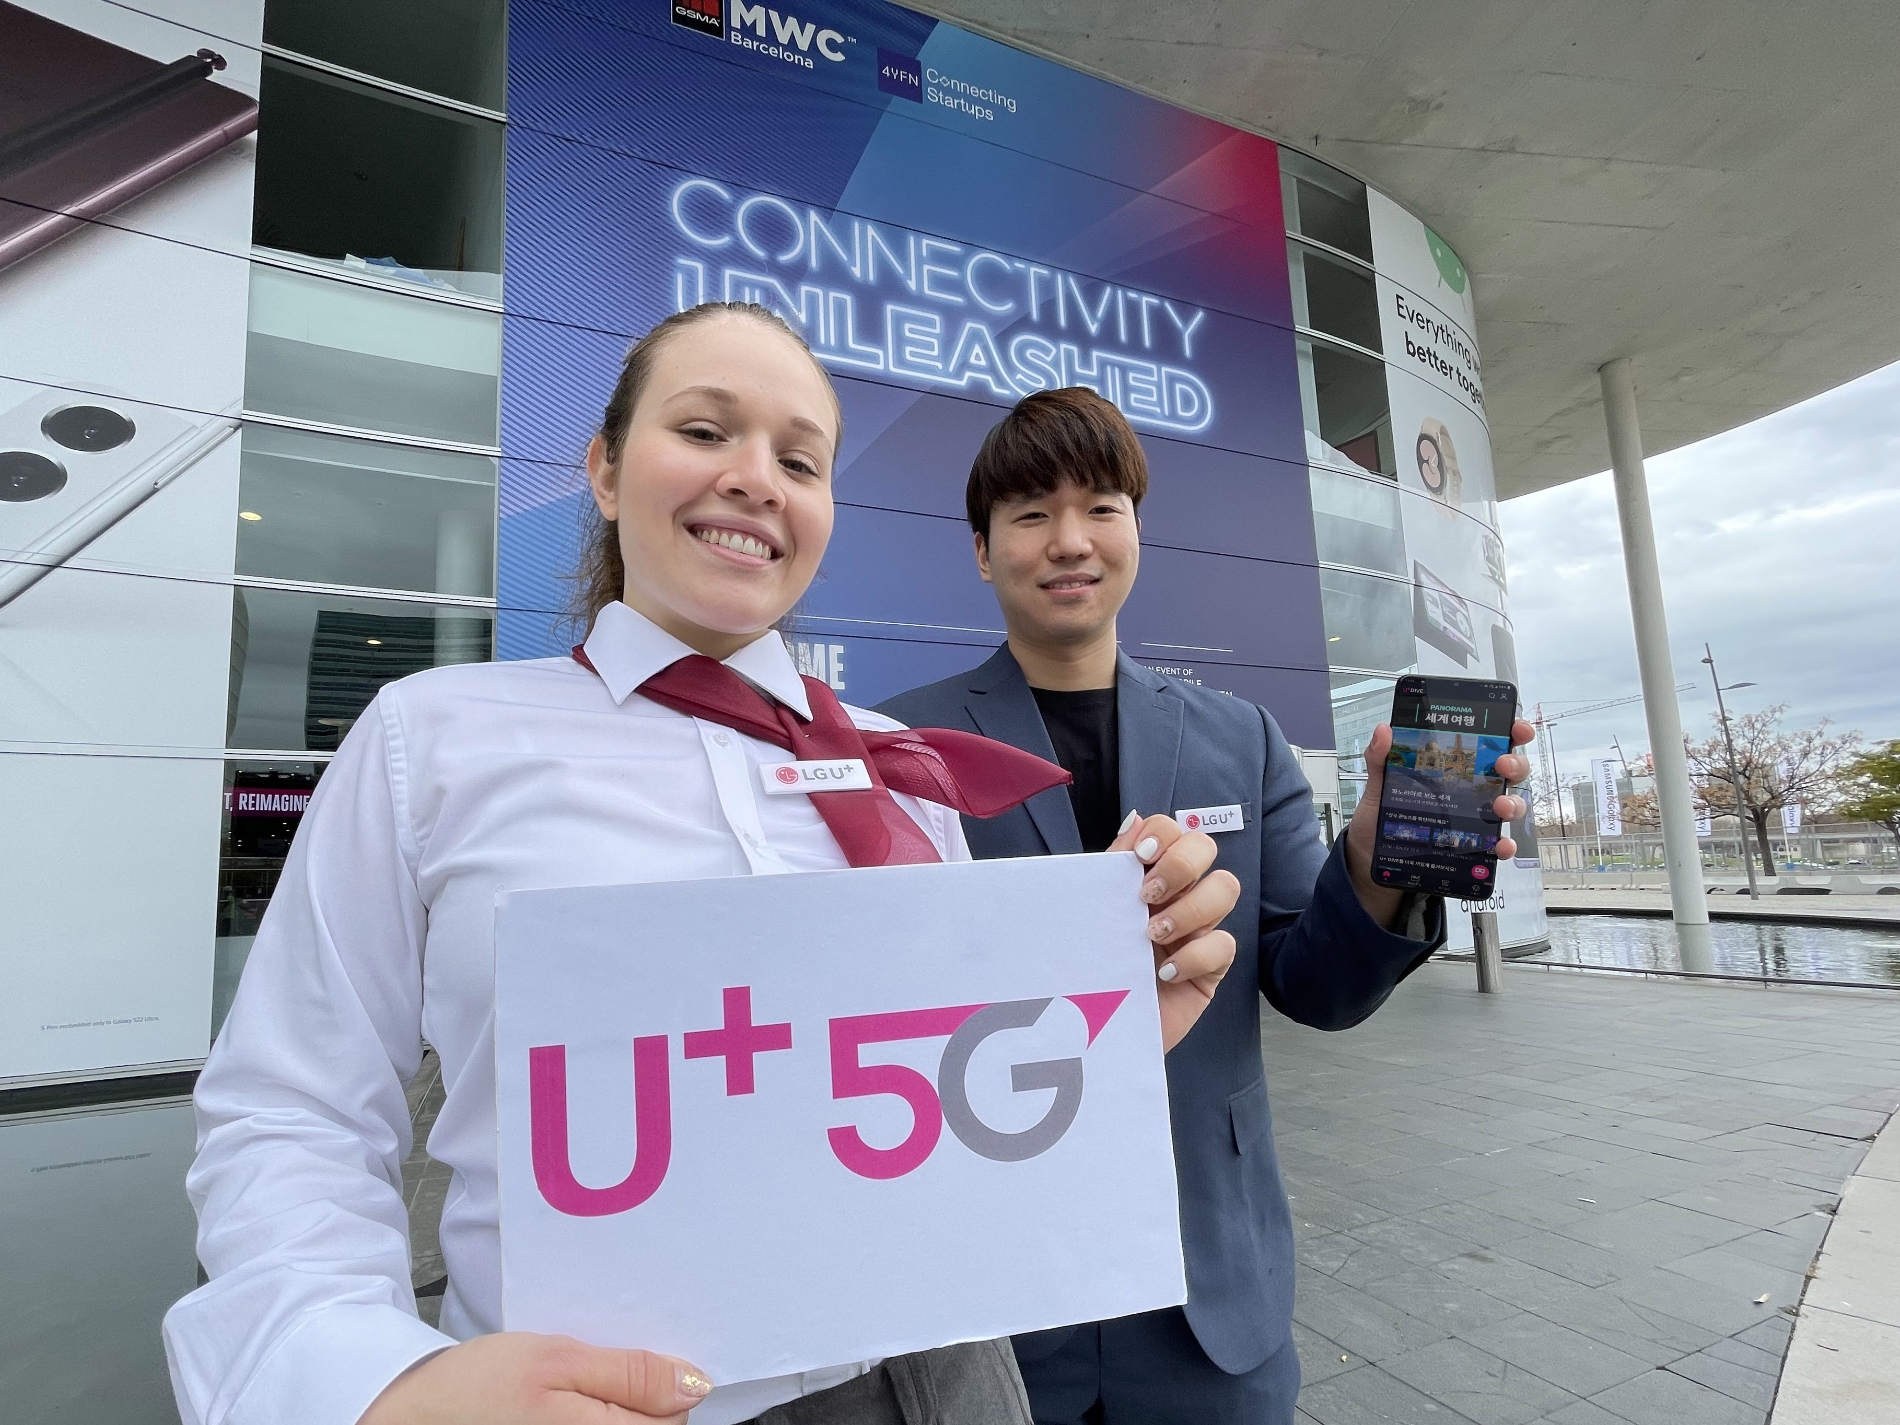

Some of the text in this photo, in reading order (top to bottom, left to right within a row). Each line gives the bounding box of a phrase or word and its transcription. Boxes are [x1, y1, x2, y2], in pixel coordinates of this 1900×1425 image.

[675, 6, 720, 27] GSMA
[730, 31, 814, 69] Barcelona
[881, 65, 919, 87] 4YFN
[926, 68, 1017, 113] Connecting
[927, 87, 994, 121] Startups
[671, 178, 1205, 360] CONNECTIVITY
[1395, 293, 1472, 371] Everything
[1404, 330, 1454, 381] better
[1182, 668, 1194, 676] OF
[1424, 712, 1476, 727] 세계 여행
[1429, 704, 1473, 714] PANORAMA
[529, 986, 1132, 1218] U+ 5G
